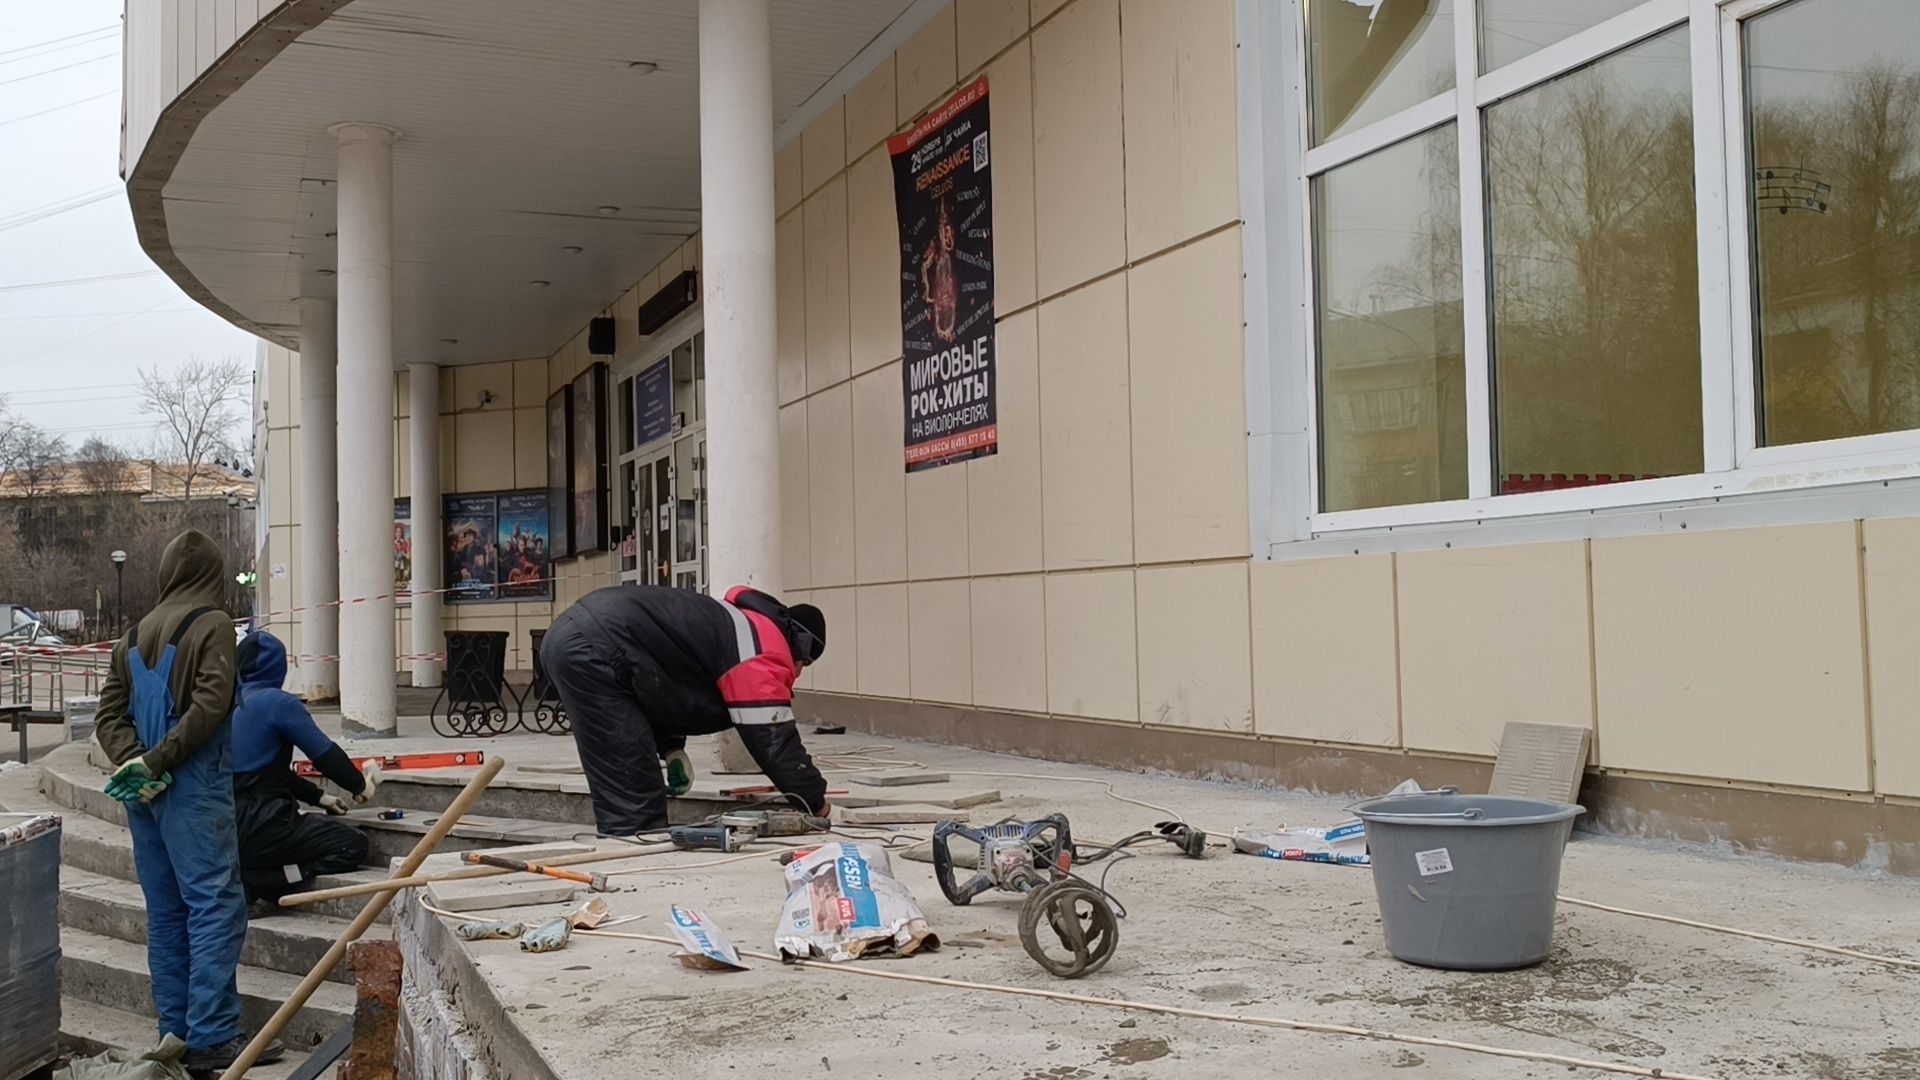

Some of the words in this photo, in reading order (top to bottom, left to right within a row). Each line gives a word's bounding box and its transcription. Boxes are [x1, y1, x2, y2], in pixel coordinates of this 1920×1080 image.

[916, 144, 971, 192] RENAISSANCE
[910, 336, 988, 391] МИРОВЫЕ
[911, 371, 988, 419] РОК-ХИТЫ
[912, 421, 924, 438] НА
[924, 402, 989, 436] ВИОЛОНЧЕЛЯХ
[906, 446, 930, 459] ТЕЛЕФОН
[839, 899, 852, 919] PLUS
